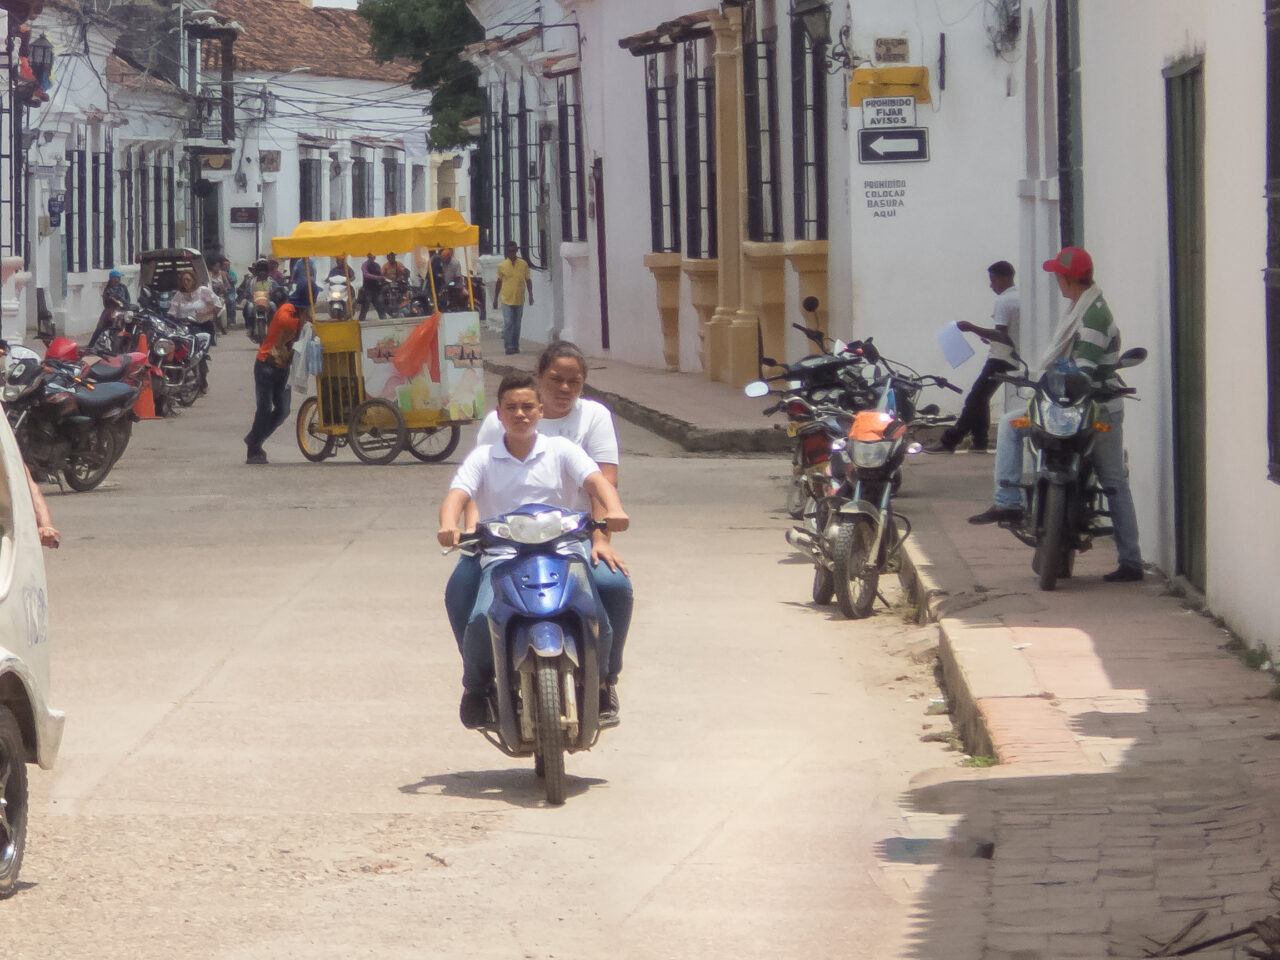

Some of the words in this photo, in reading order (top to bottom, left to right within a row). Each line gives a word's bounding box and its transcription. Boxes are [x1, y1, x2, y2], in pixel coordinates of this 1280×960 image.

[865, 98, 912, 107] PROHIBIDO
[876, 108, 904, 116] FIJAR
[870, 117, 907, 125] AVISOS
[865, 189, 906, 198] COLOCAR
[867, 198, 905, 208] BASURA
